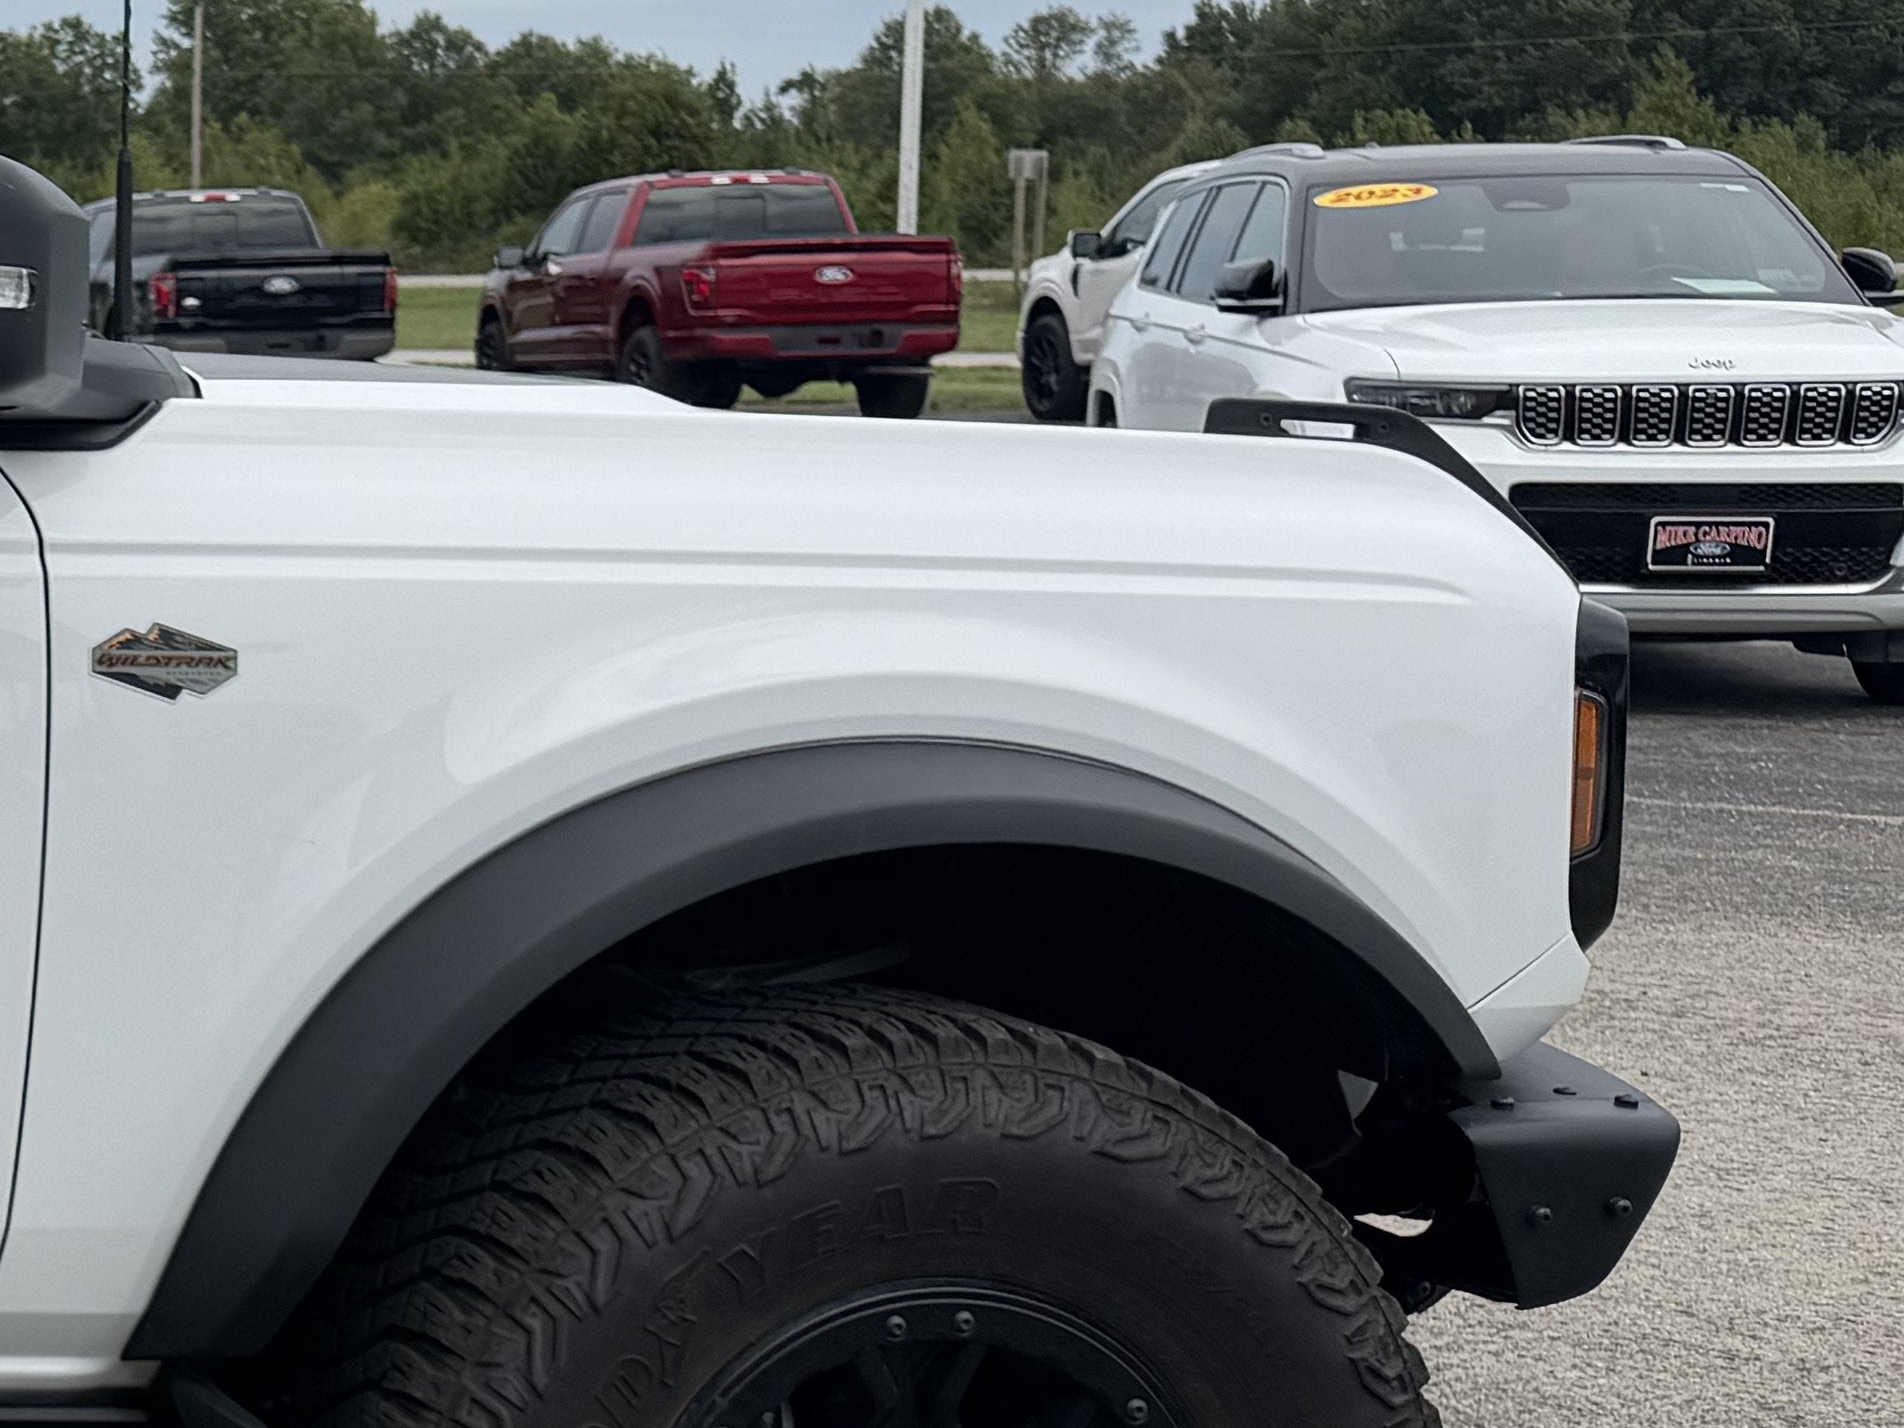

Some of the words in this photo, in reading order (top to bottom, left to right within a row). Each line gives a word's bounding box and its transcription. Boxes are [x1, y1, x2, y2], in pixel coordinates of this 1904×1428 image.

[1330, 187, 1425, 204] 2023
[1688, 357, 1736, 371] Jeep
[1655, 525, 1696, 550] MIKE
[1697, 525, 1766, 550] CARPINO
[97, 653, 235, 670] WILDTRAK
